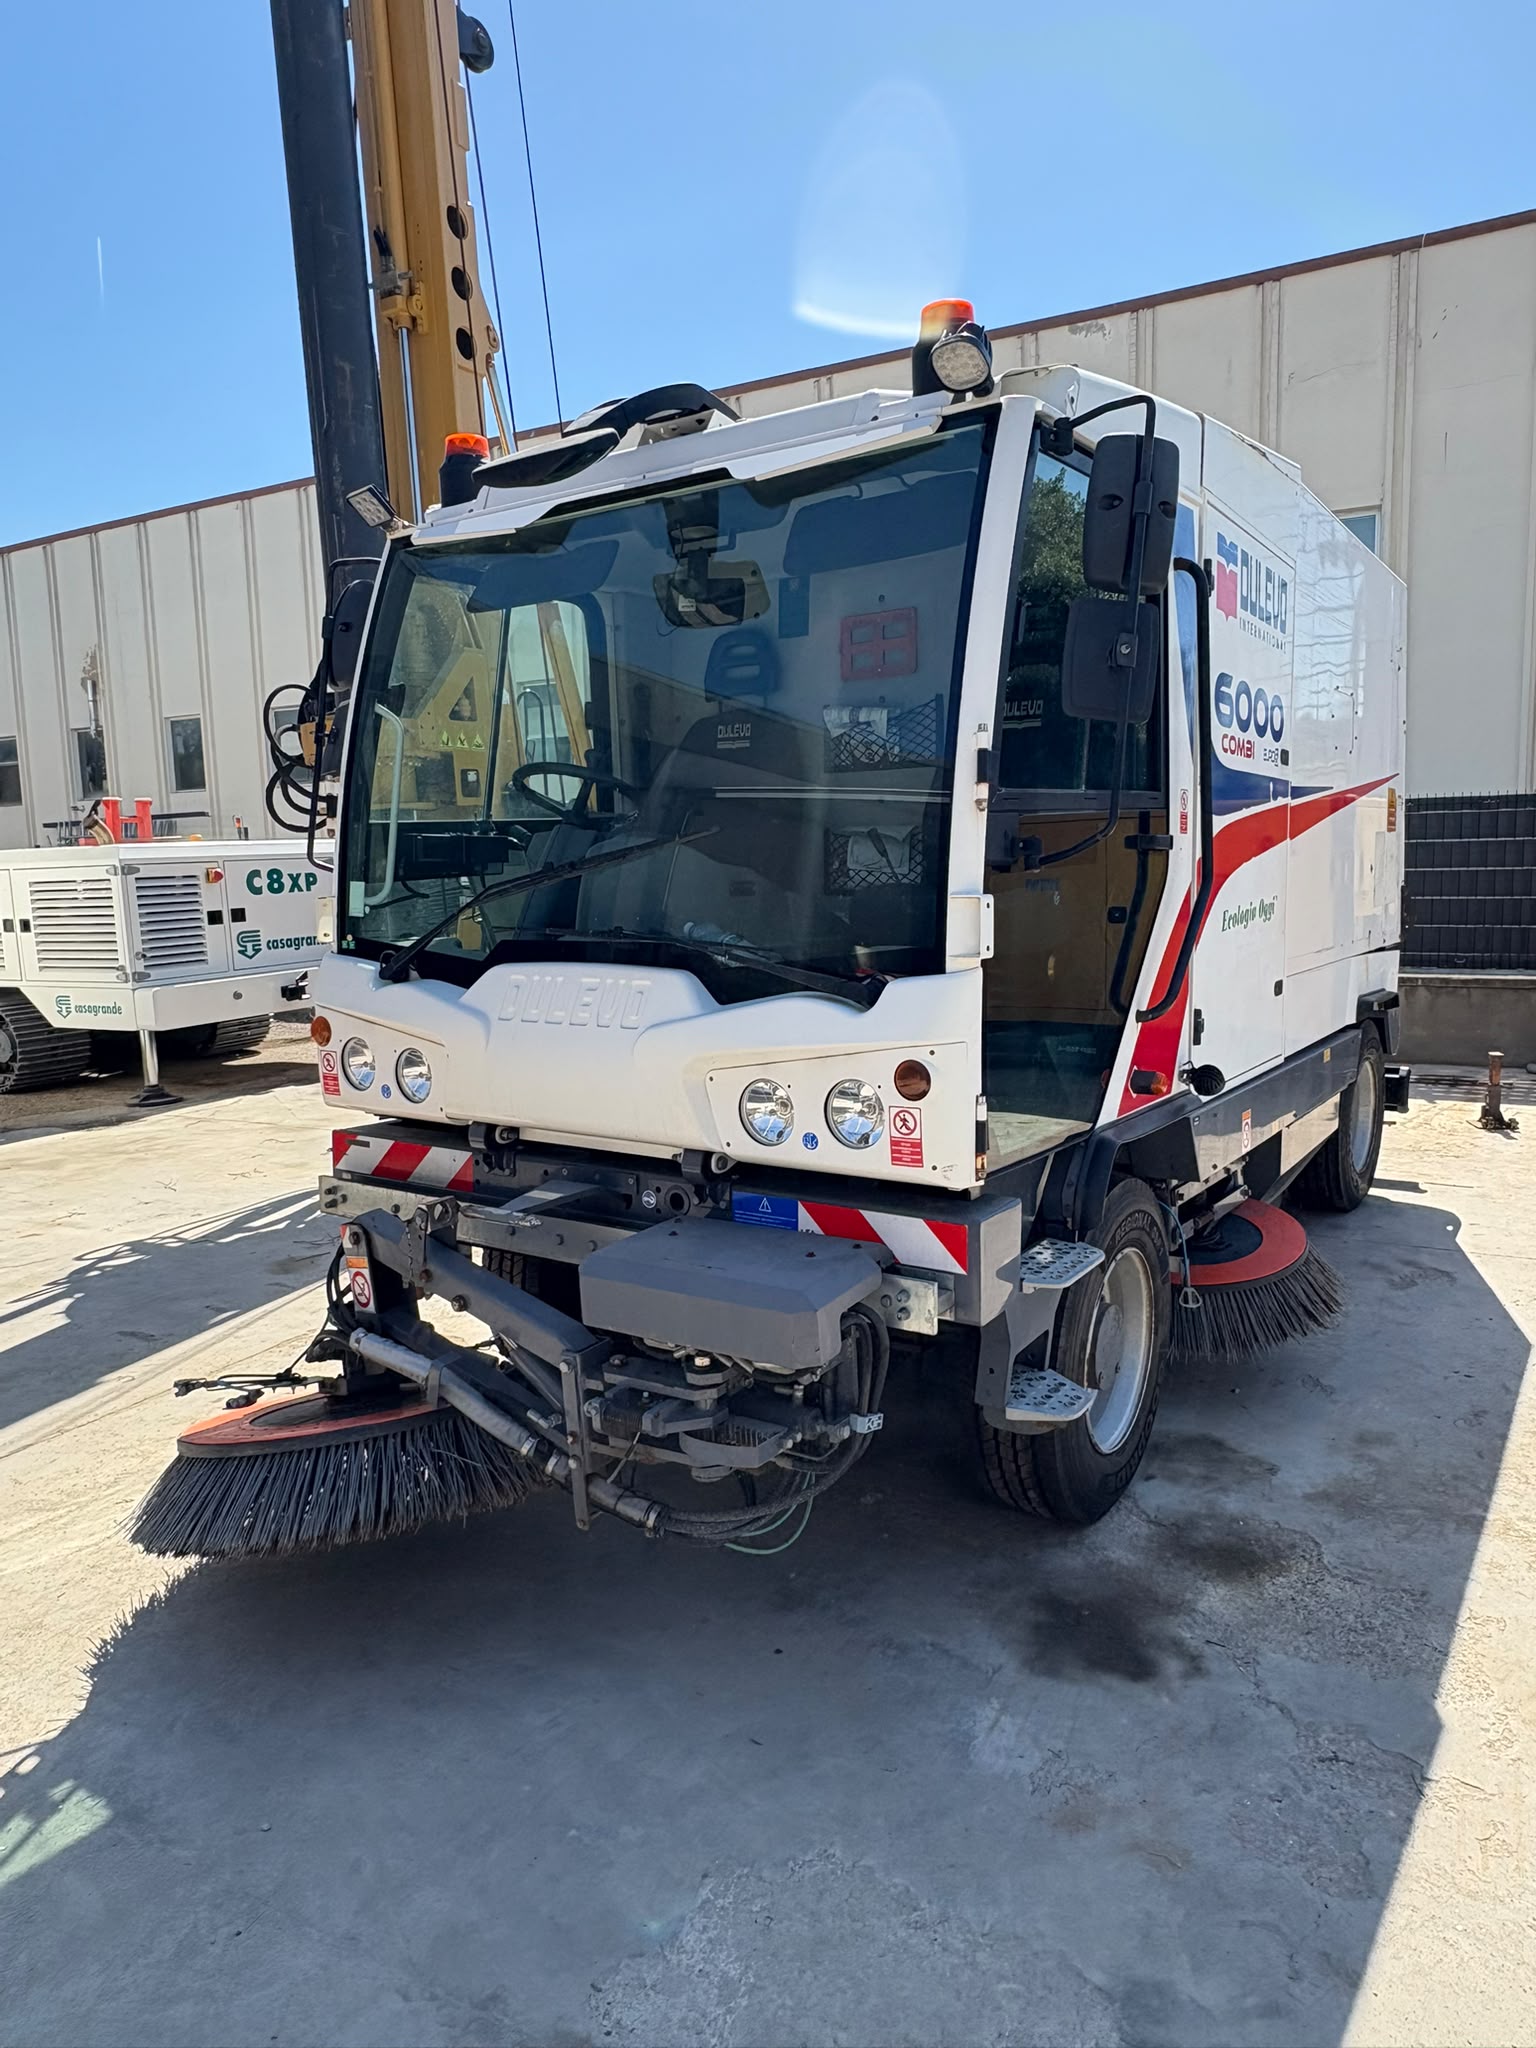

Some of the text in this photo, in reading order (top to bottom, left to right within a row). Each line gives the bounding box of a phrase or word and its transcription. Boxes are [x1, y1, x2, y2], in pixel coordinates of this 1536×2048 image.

[1240, 548, 1288, 635] DULEVO
[1239, 616, 1287, 655] INTERNATIONAL
[1214, 672, 1285, 743] 6000
[717, 723, 751, 738] DULEVO
[1221, 733, 1255, 760] COMBI
[246, 868, 318, 896] C8XP
[1221, 901, 1257, 932] Ecologia
[74, 1001, 123, 1017] casagrande
[498, 974, 652, 1030] DULEVO
